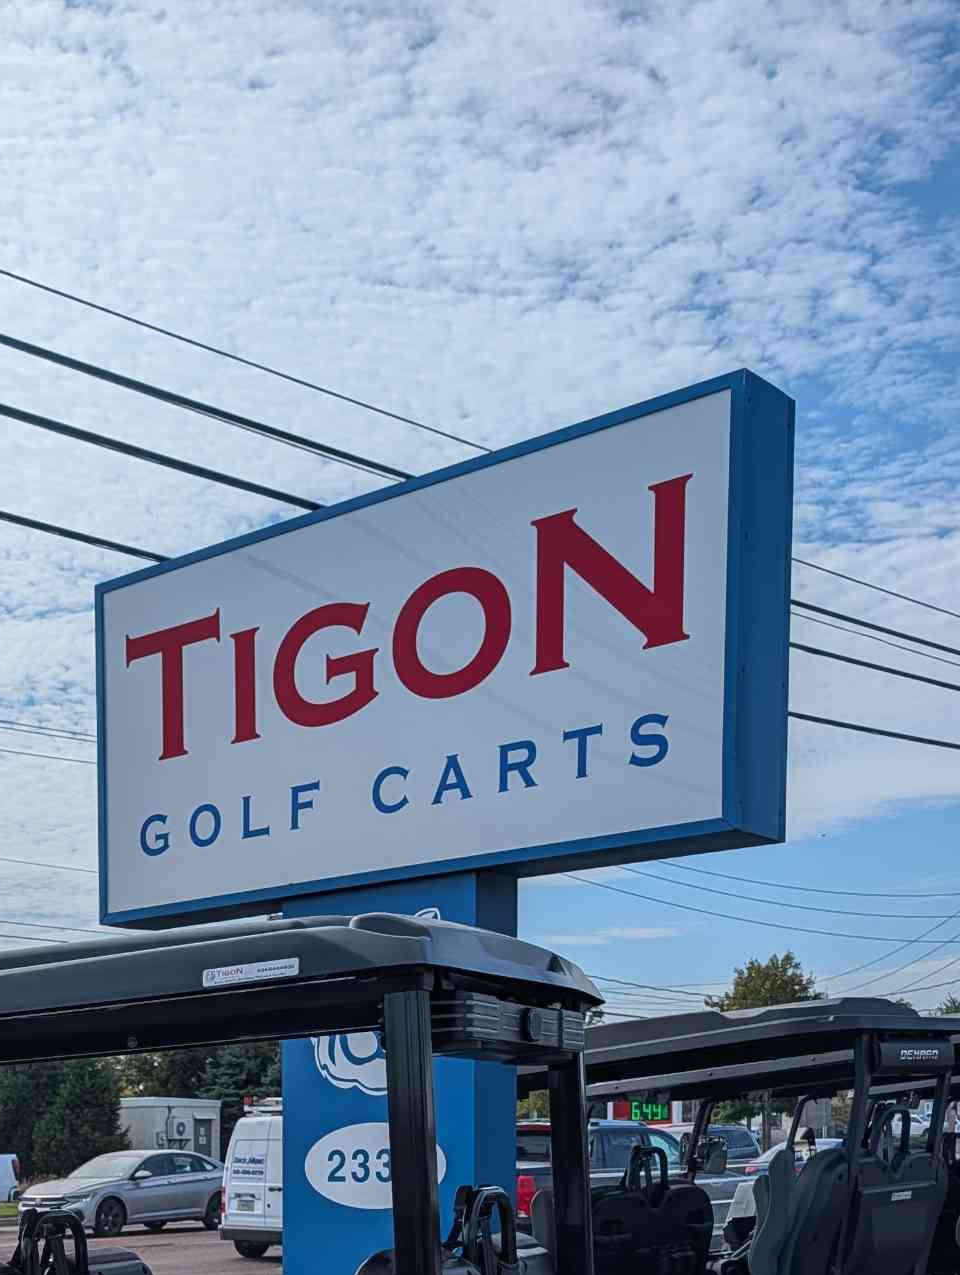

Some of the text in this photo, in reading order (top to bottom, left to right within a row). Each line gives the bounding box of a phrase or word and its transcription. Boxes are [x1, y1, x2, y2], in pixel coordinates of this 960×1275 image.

[125, 473, 694, 761] TIGON
[139, 713, 671, 857] GOLF CARTS
